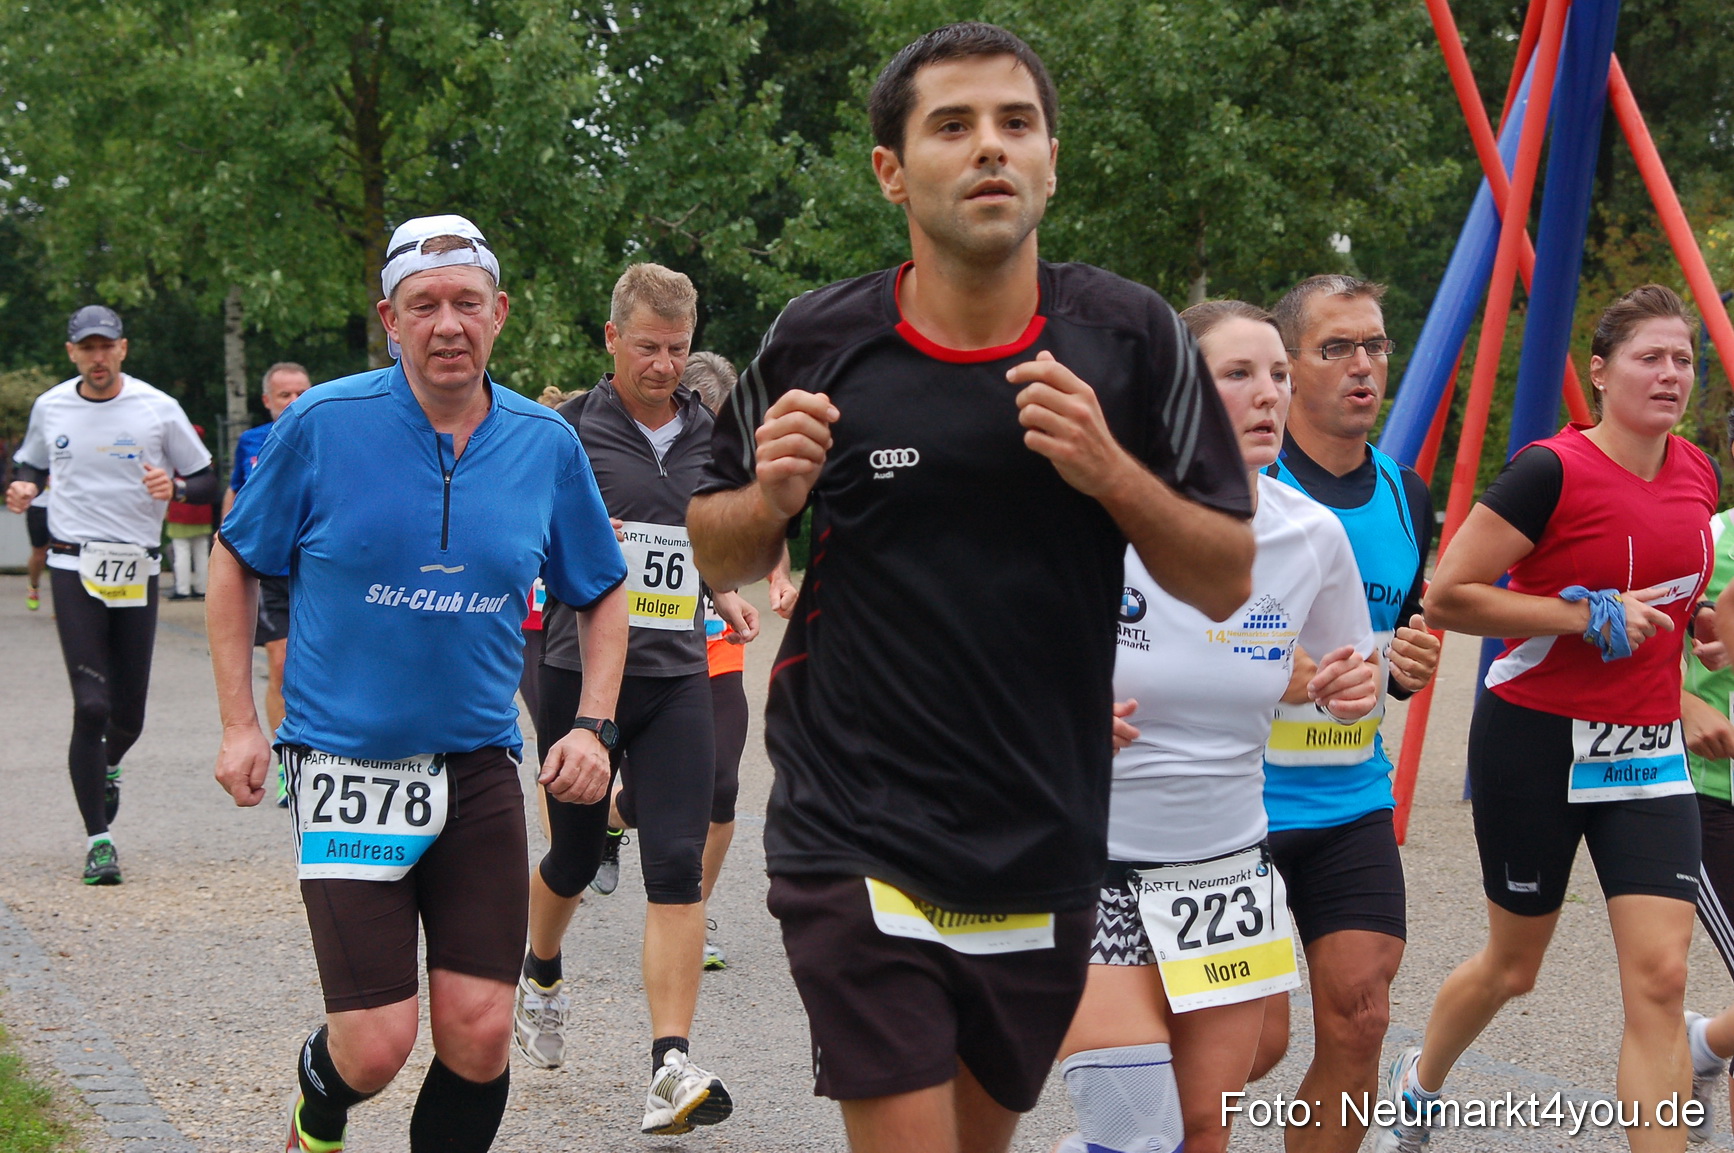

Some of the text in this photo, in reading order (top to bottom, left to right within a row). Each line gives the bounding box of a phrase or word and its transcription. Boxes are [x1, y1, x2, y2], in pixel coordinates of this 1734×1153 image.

[873, 470, 894, 480] Audi
[621, 531, 691, 548] ARTL Neumar
[95, 560, 137, 582] 474
[643, 550, 685, 590] 56
[465, 592, 510, 613] Lauf
[636, 597, 681, 617] Holger
[1116, 623, 1151, 642] ARTL
[1205, 629, 1231, 644] 14.
[1116, 637, 1150, 652] umarkt
[1305, 727, 1362, 747] Roland
[350, 757, 422, 773] Neumarkt
[1603, 764, 1658, 783] Andrea
[312, 773, 432, 827] 2578
[326, 838, 405, 861] Andreas
[1188, 869, 1252, 890] Neumarkt
[1171, 885, 1264, 951] 223
[1203, 960, 1251, 984] Nora
